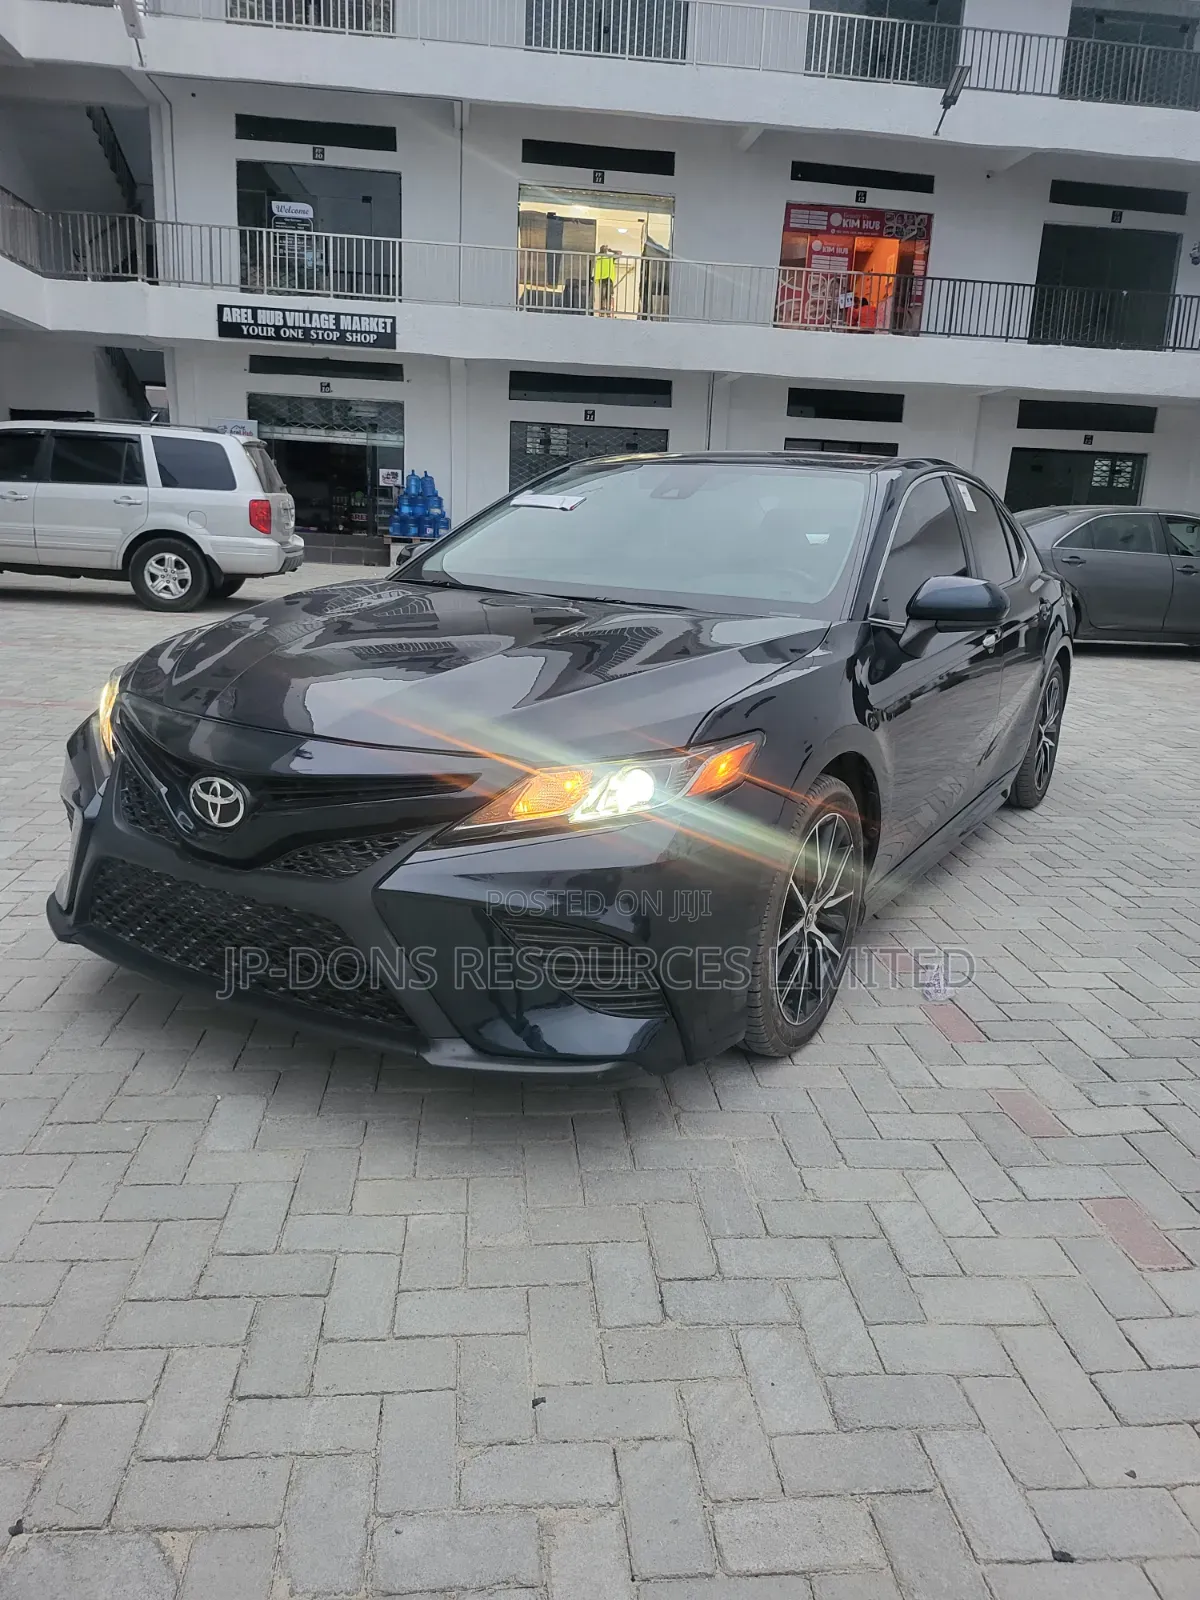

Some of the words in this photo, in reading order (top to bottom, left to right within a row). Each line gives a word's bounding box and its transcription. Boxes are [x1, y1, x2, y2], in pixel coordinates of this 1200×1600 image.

[275, 204, 310, 215] Welcome
[842, 218, 860, 229] KIM
[862, 219, 881, 230] HUB
[822, 245, 835, 254] KIM
[222, 307, 254, 324] AREL
[257, 309, 284, 326] HUB
[285, 311, 336, 330] VILLAGE
[340, 315, 393, 333] MARKET
[241, 324, 277, 338] YOUR
[280, 328, 304, 339] ONE
[310, 329, 340, 341] STOP
[345, 332, 378, 344] SHOP
